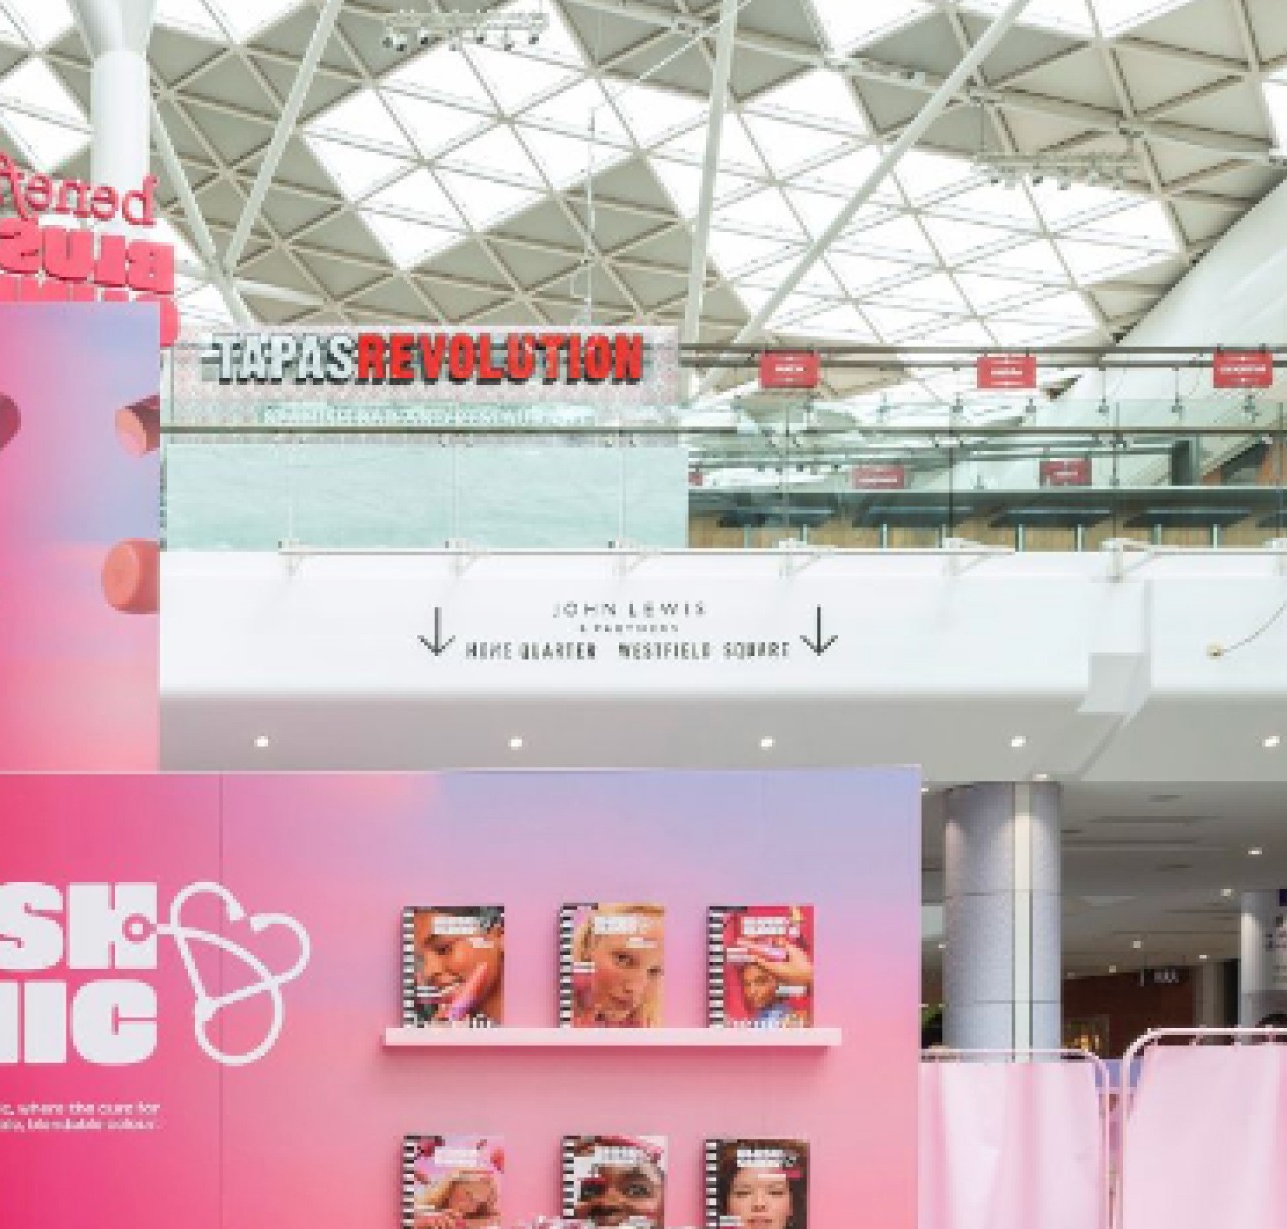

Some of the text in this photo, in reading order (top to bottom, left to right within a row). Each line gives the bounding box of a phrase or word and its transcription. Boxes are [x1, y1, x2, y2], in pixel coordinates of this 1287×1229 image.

[553, 601, 706, 618] JOHN LEWIS
[518, 642, 596, 660] QUARTER
[618, 642, 711, 660] WESTFIELD
[723, 642, 790, 660] SQUARE
